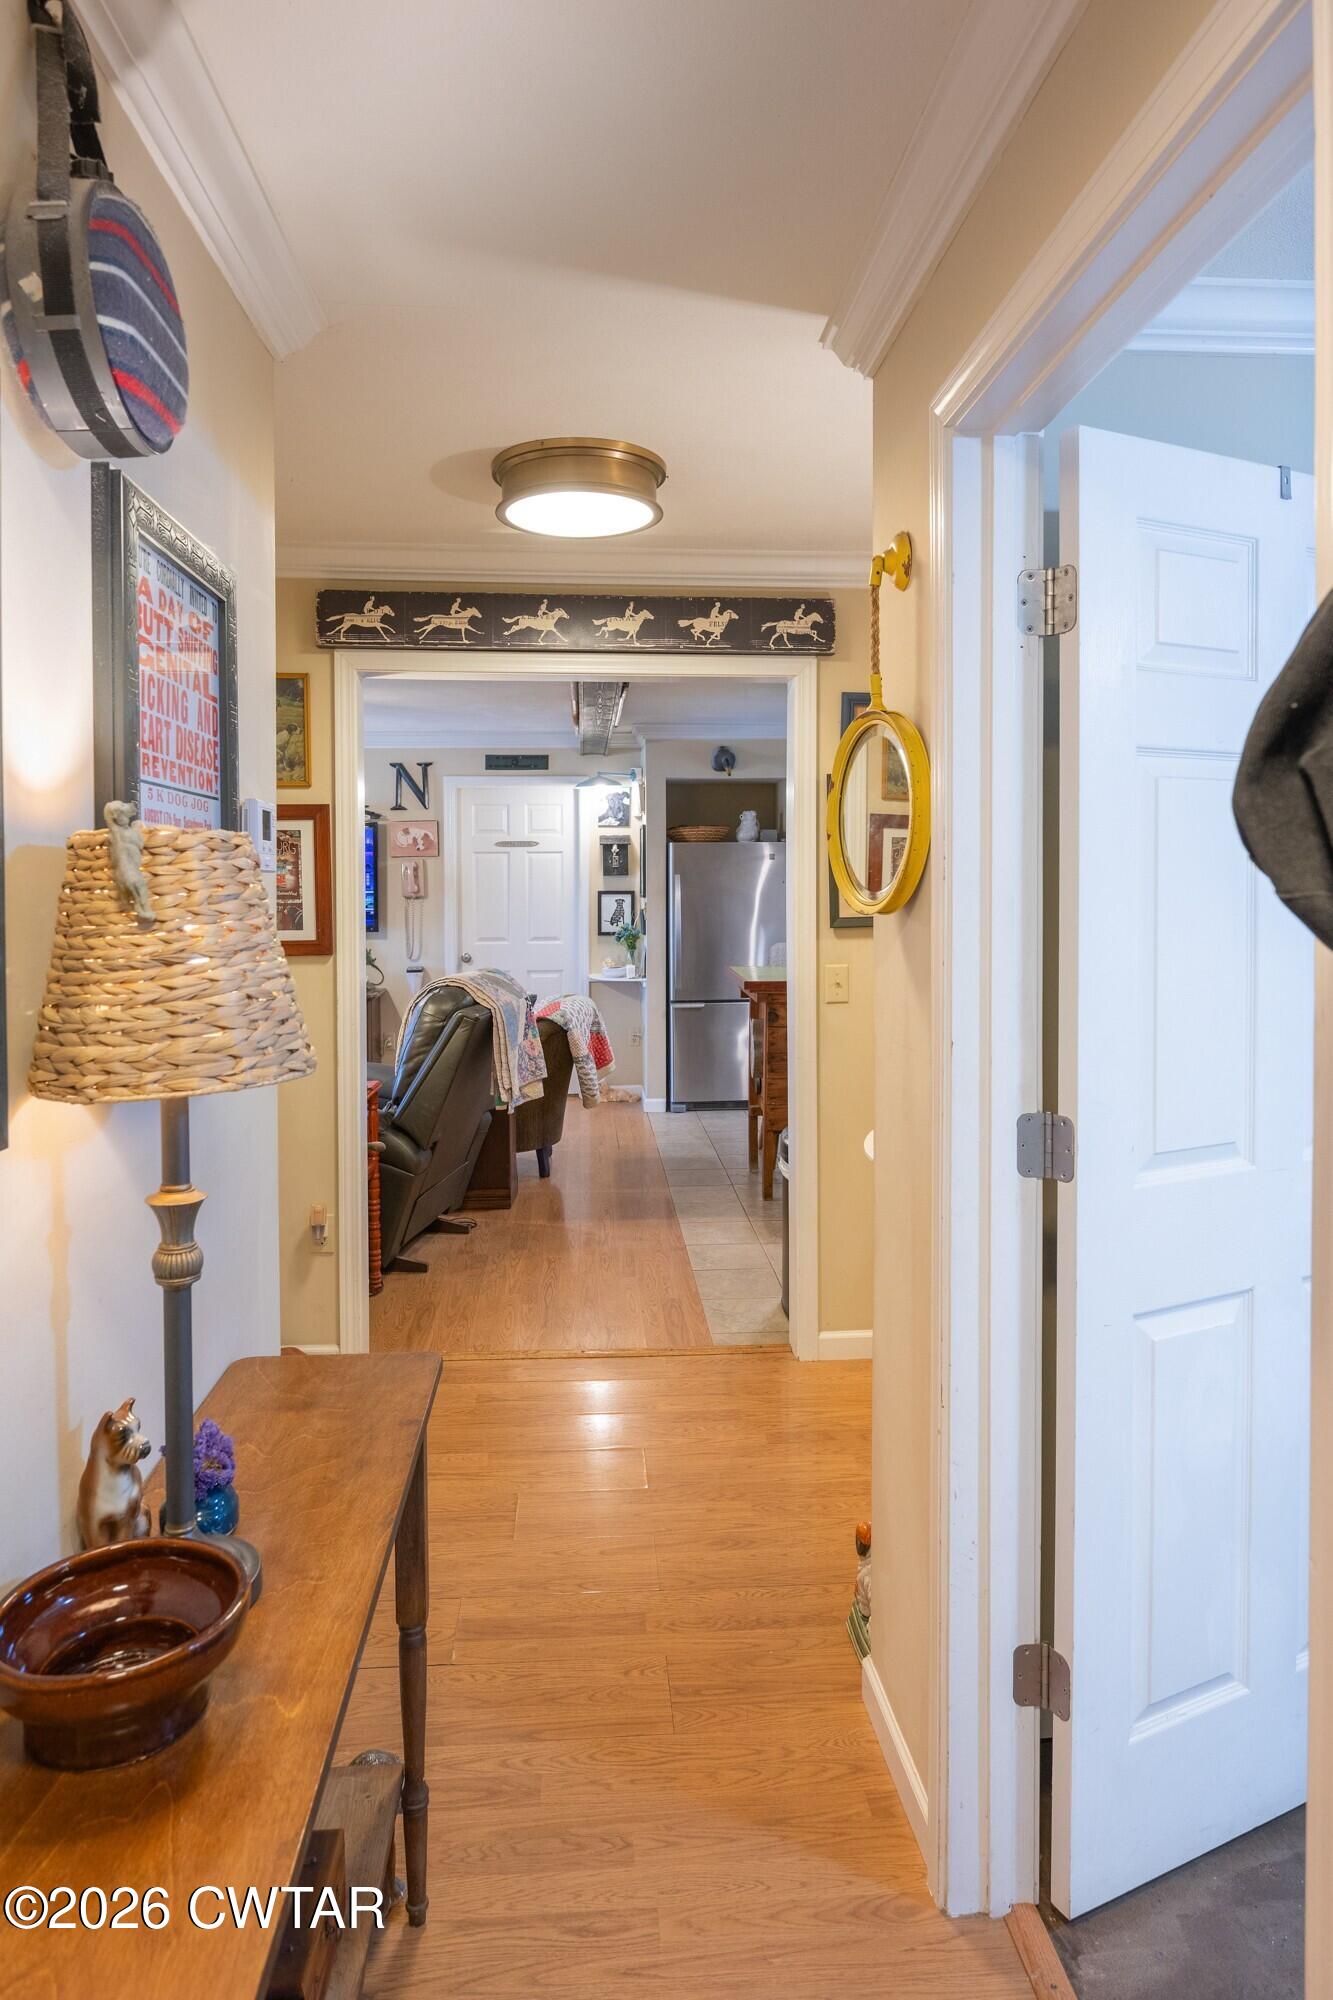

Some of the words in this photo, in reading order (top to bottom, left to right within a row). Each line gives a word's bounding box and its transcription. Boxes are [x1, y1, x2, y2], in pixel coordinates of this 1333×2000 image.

[137, 575, 153, 604] A
[158, 587, 184, 621] DAY
[188, 611, 214, 640] OF
[140, 669, 189, 724] ICKING
[197, 698, 219, 737] AND
[140, 710, 172, 756] EART
[176, 724, 219, 773] DISEASE
[142, 751, 219, 796] REVENTION!
[147, 786, 153, 800] 5
[157, 788, 164, 803] K
[167, 791, 188, 808] DOG
[191, 797, 209, 813] JOG
[389, 761, 434, 811] N
